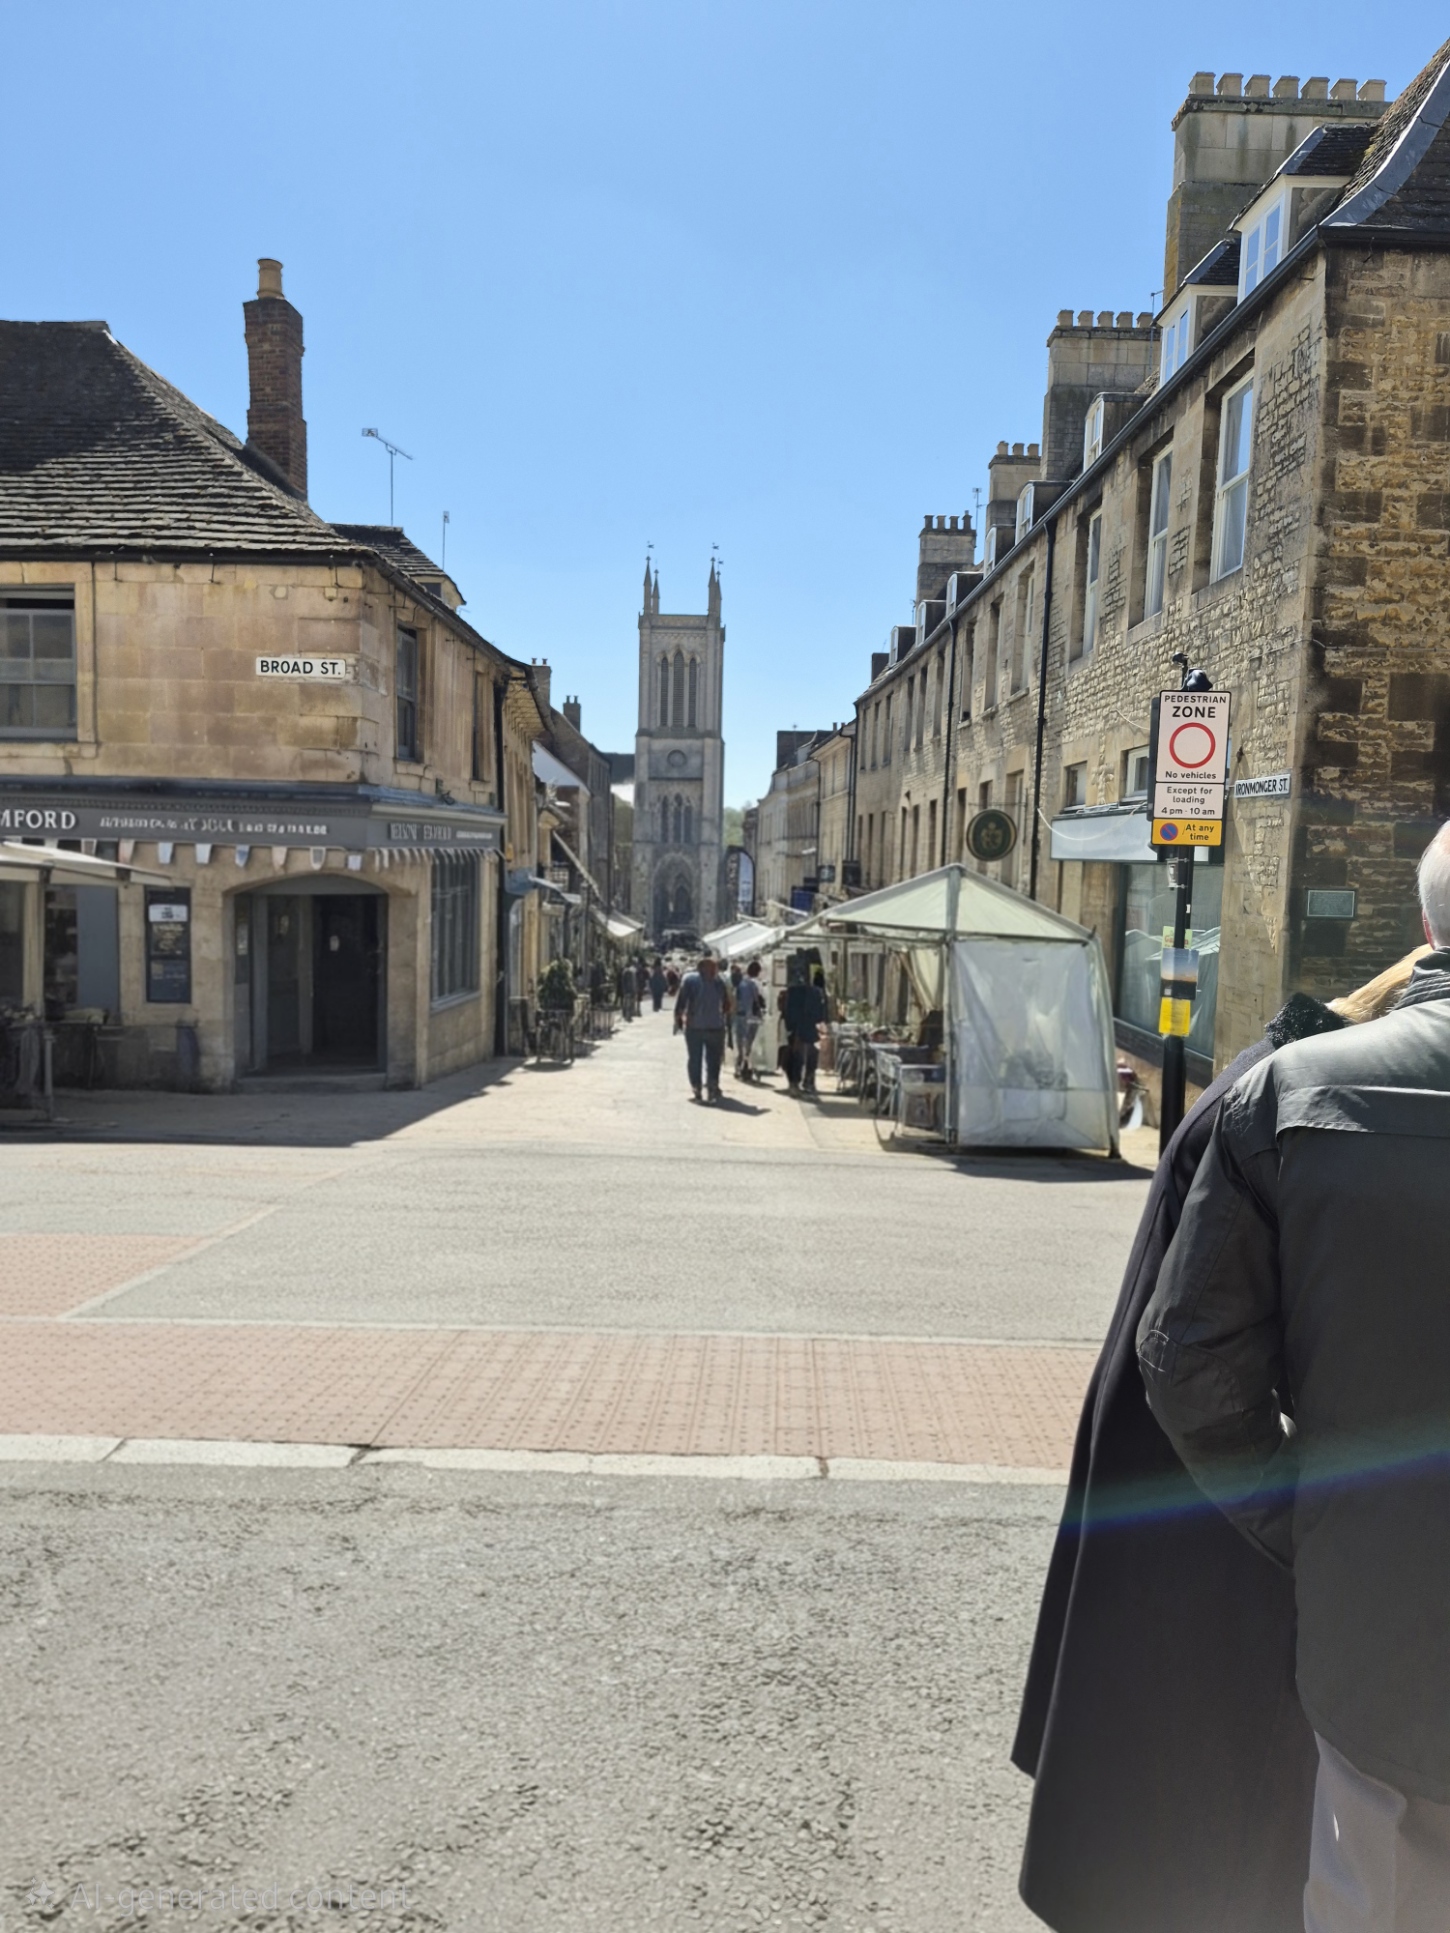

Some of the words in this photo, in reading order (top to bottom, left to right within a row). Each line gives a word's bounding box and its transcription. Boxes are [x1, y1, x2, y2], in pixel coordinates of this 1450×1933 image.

[260, 660, 314, 674] BROAD
[320, 661, 341, 675] ST.
[1164, 695, 1227, 704] PEDESTRIAN
[1172, 706, 1216, 718] ZONE
[1165, 771, 1178, 779] No
[1180, 771, 1217, 780] vehicles
[1278, 777, 1288, 792] ST.
[1166, 786, 1197, 795] Except
[1200, 787, 1213, 795] for
[1172, 795, 1206, 805] loading
[1169, 808, 1183, 816] pm
[1189, 807, 1201, 815] 10
[1202, 808, 1215, 816] am
[1185, 823, 1196, 831] At
[1198, 825, 1215, 833] any
[1189, 833, 1209, 841] time
